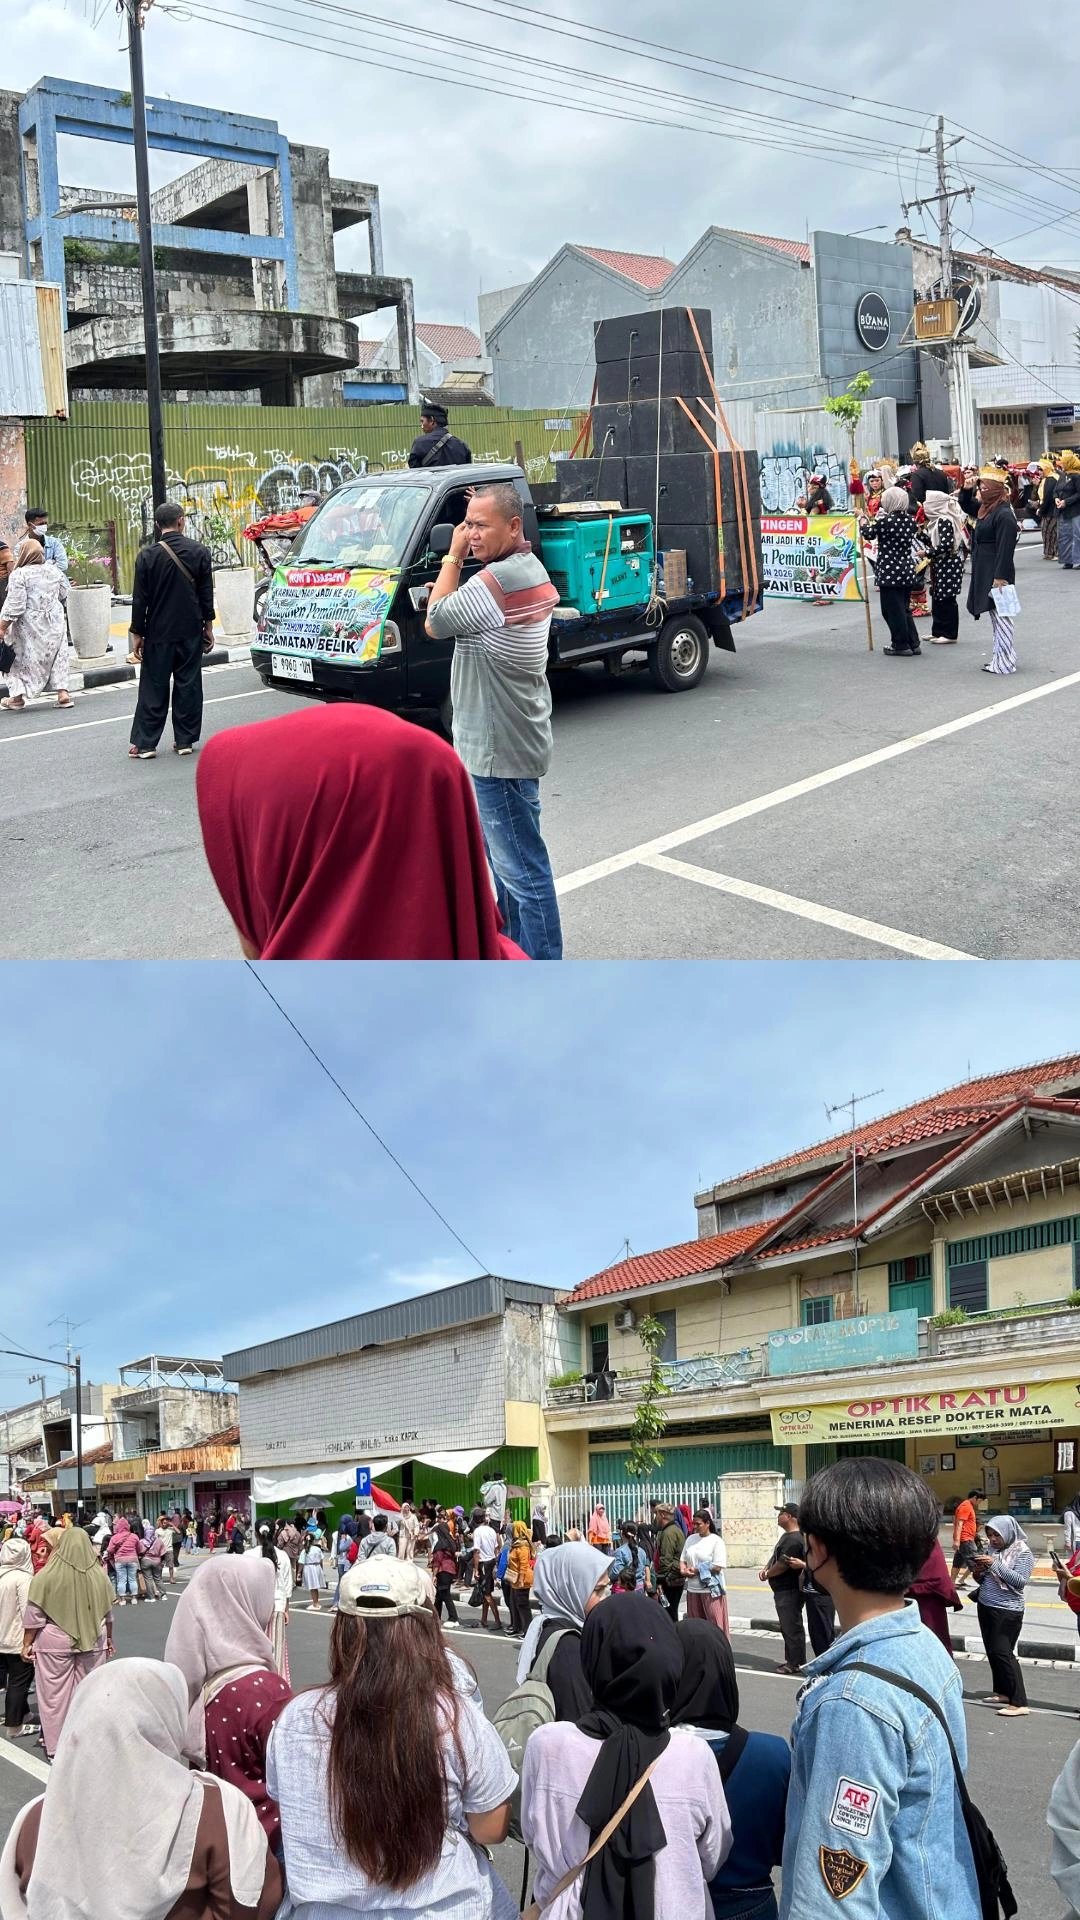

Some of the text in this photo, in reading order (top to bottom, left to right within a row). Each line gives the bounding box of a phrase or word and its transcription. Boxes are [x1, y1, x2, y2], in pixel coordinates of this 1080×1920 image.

[776, 536, 792, 545] JADI
[795, 536, 805, 545] KE
[808, 537, 822, 546] 451
[774, 570, 793, 578] 2026
[794, 582, 838, 595] BELIK
[304, 624, 320, 634] 2026
[258, 634, 356, 654] KECAMATAN BELIK
[848, 1384, 1029, 1418] OPTIK RATU
[829, 1405, 1052, 1432] MENERIMA RESEP DOKTER MATA
[360, 1472, 368, 1490] P
[836, 1815, 852, 1826] SINCE
